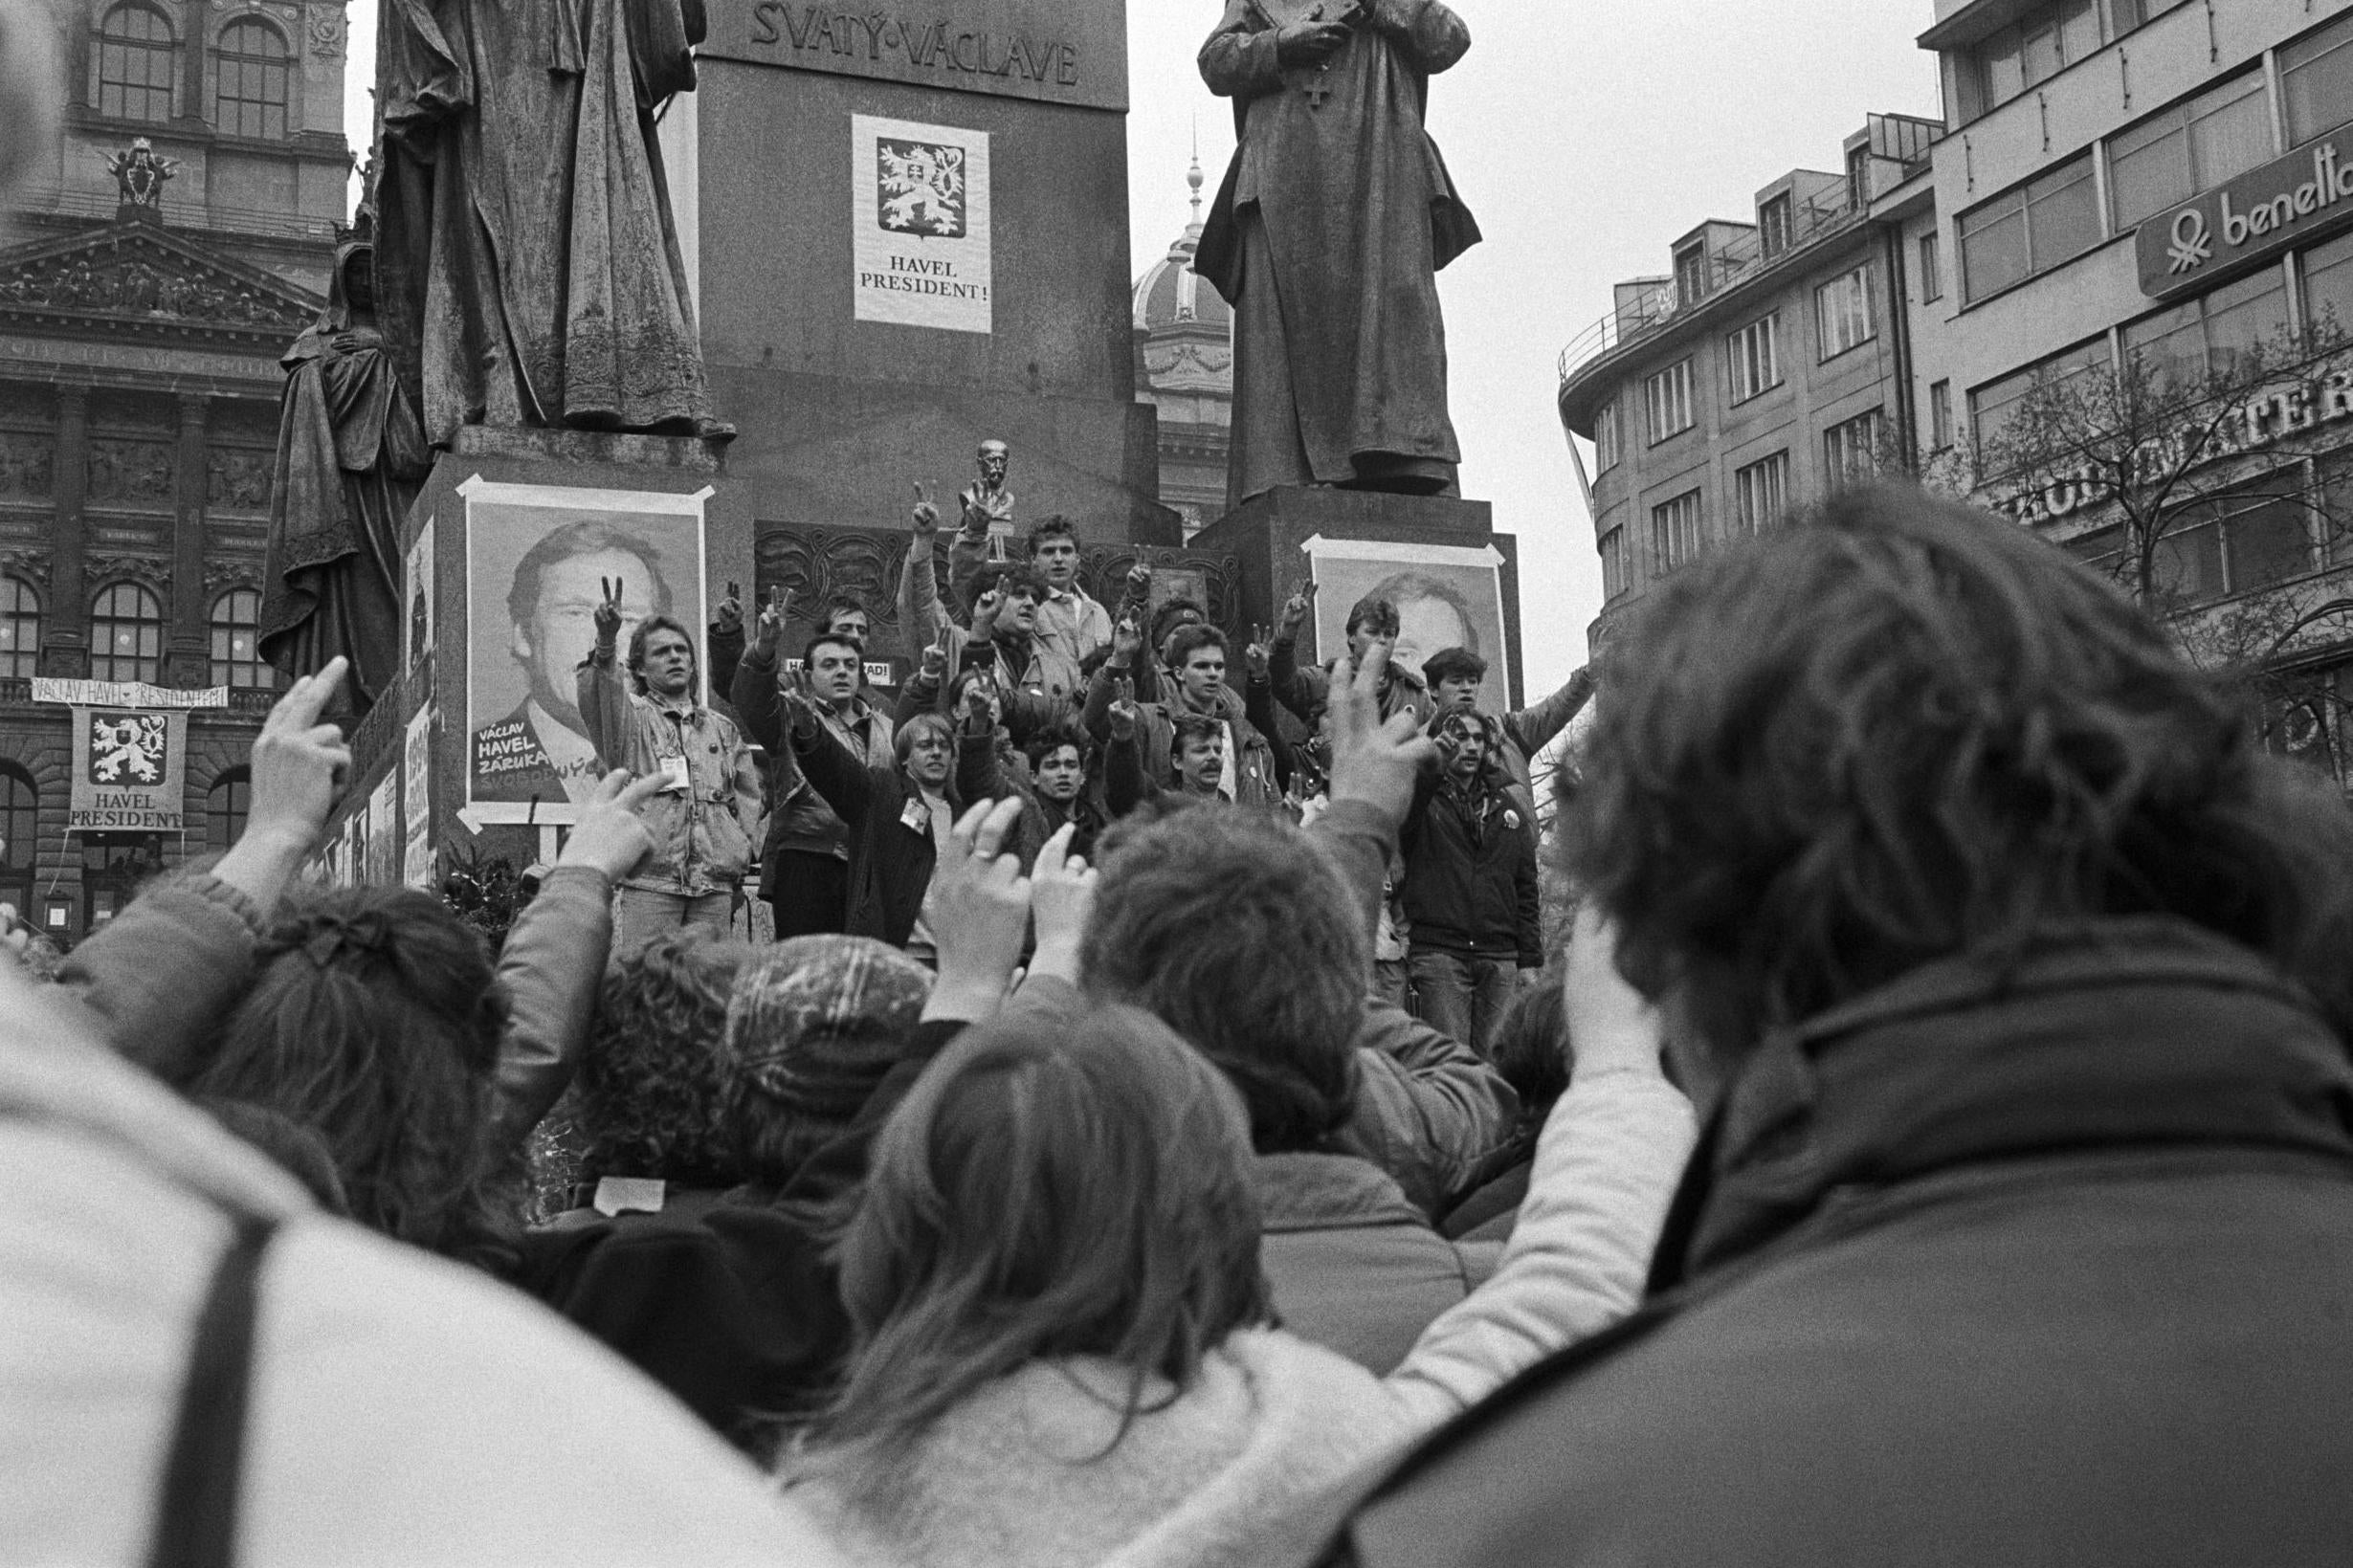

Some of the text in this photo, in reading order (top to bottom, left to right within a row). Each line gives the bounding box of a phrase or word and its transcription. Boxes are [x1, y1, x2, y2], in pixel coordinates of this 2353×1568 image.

[890, 255, 958, 277] HAVEL
[860, 272, 988, 301] PRESIDENT!
[88, 681, 123, 704] HAVEL
[478, 721, 525, 741] VÁCLAV
[478, 736, 536, 759] HAVEL
[478, 750, 550, 775] ZÁRUKA
[95, 792, 156, 809] HAVEL
[70, 810, 183, 828] PRESIDENT
